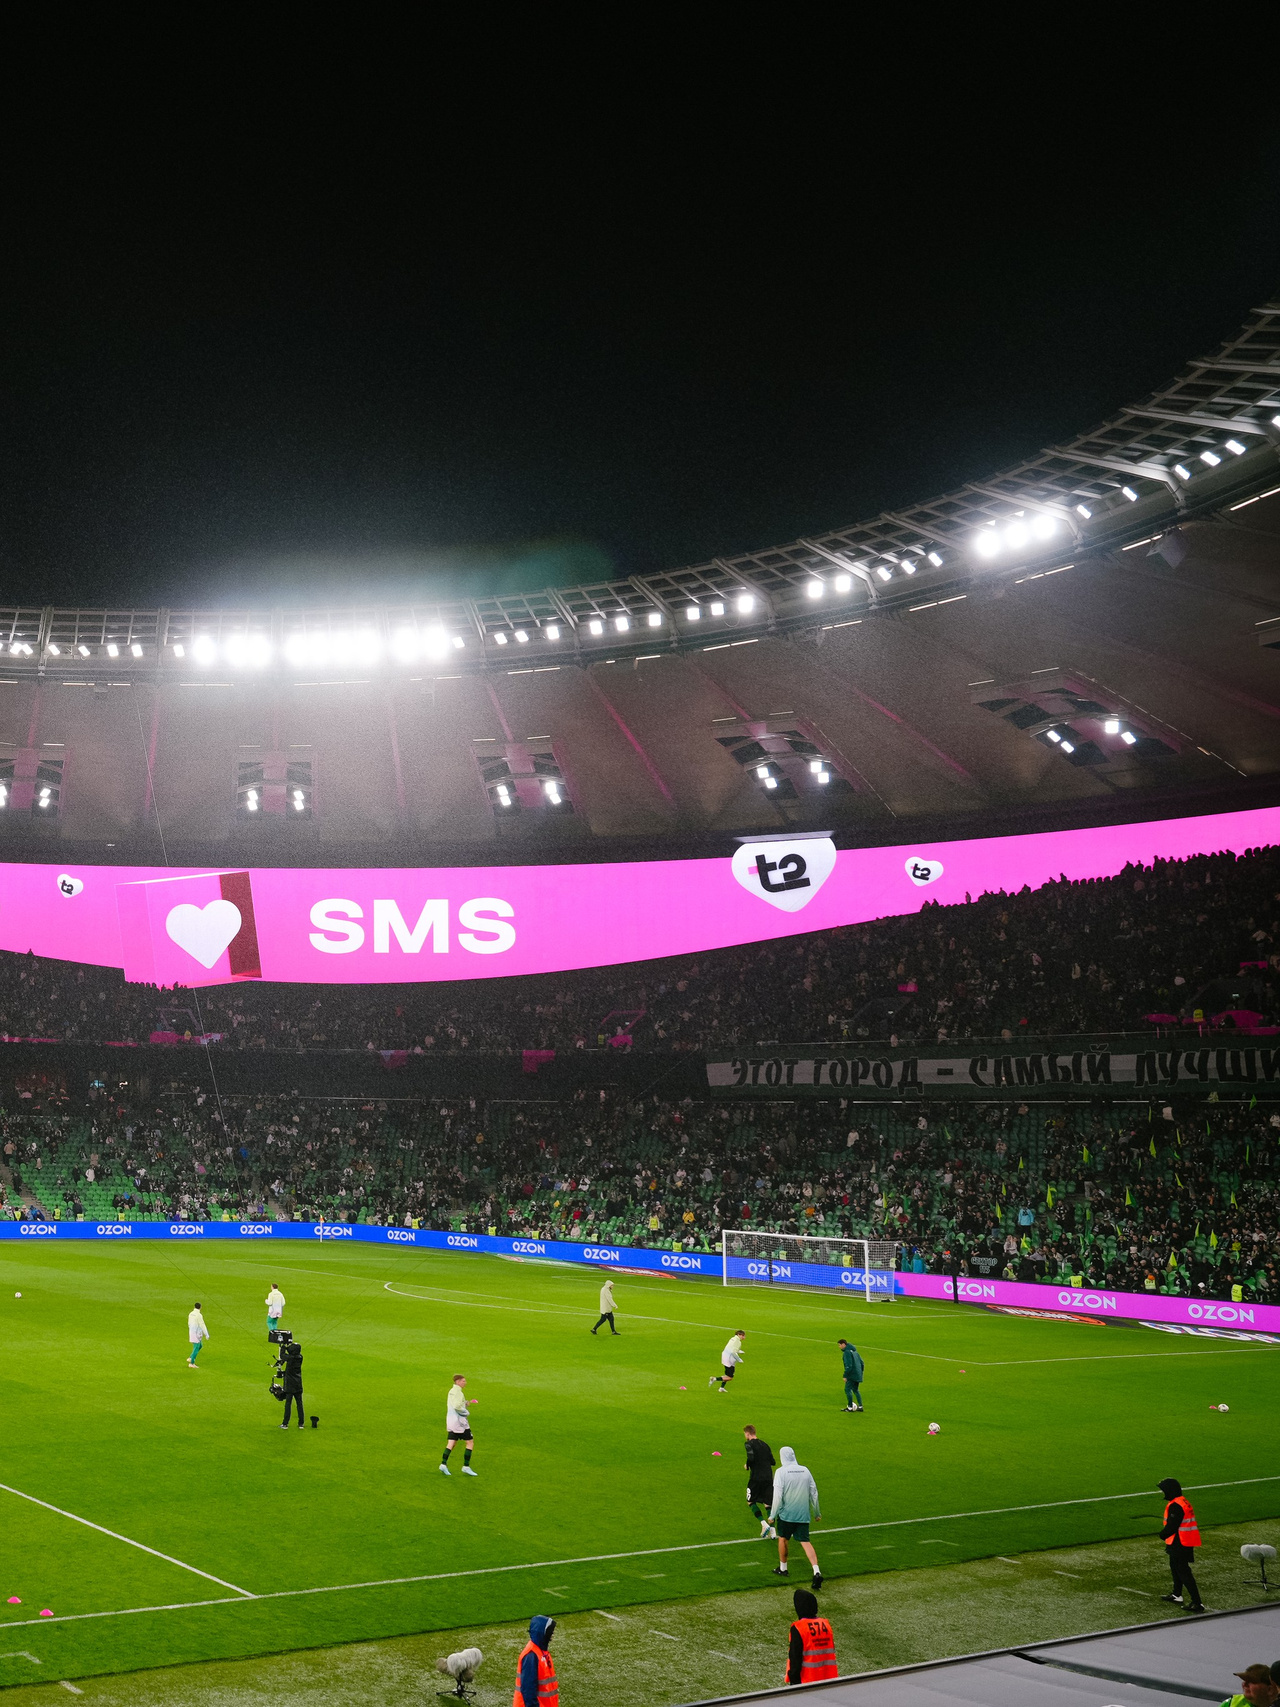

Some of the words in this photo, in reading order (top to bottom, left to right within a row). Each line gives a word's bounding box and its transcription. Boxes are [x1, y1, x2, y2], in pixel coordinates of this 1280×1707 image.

[747, 853, 811, 893] t2
[910, 863, 931, 881] t2
[60, 879, 74, 895] t2
[308, 897, 517, 955] SMS
[730, 1056, 799, 1088] ЭТОТ
[813, 1055, 925, 1096] ГОРОД
[968, 1043, 1114, 1089] САМЫЙ
[20, 1224, 57, 1235] OZON
[97, 1224, 132, 1235] OZON
[170, 1224, 204, 1235] OZON
[239, 1224, 273, 1235] OZON
[314, 1225, 353, 1237] OZON
[387, 1229, 416, 1241] OZON
[447, 1235, 478, 1247] OZON
[512, 1241, 546, 1254] OZON
[583, 1248, 620, 1261] OZON
[661, 1254, 701, 1269] OZON
[747, 1262, 792, 1278] OZON
[841, 1271, 888, 1288] OZON
[943, 1280, 996, 1298] OZON
[1057, 1291, 1117, 1310] OZON
[1187, 1303, 1255, 1324] OZON
[808, 1621, 828, 1637] 574
